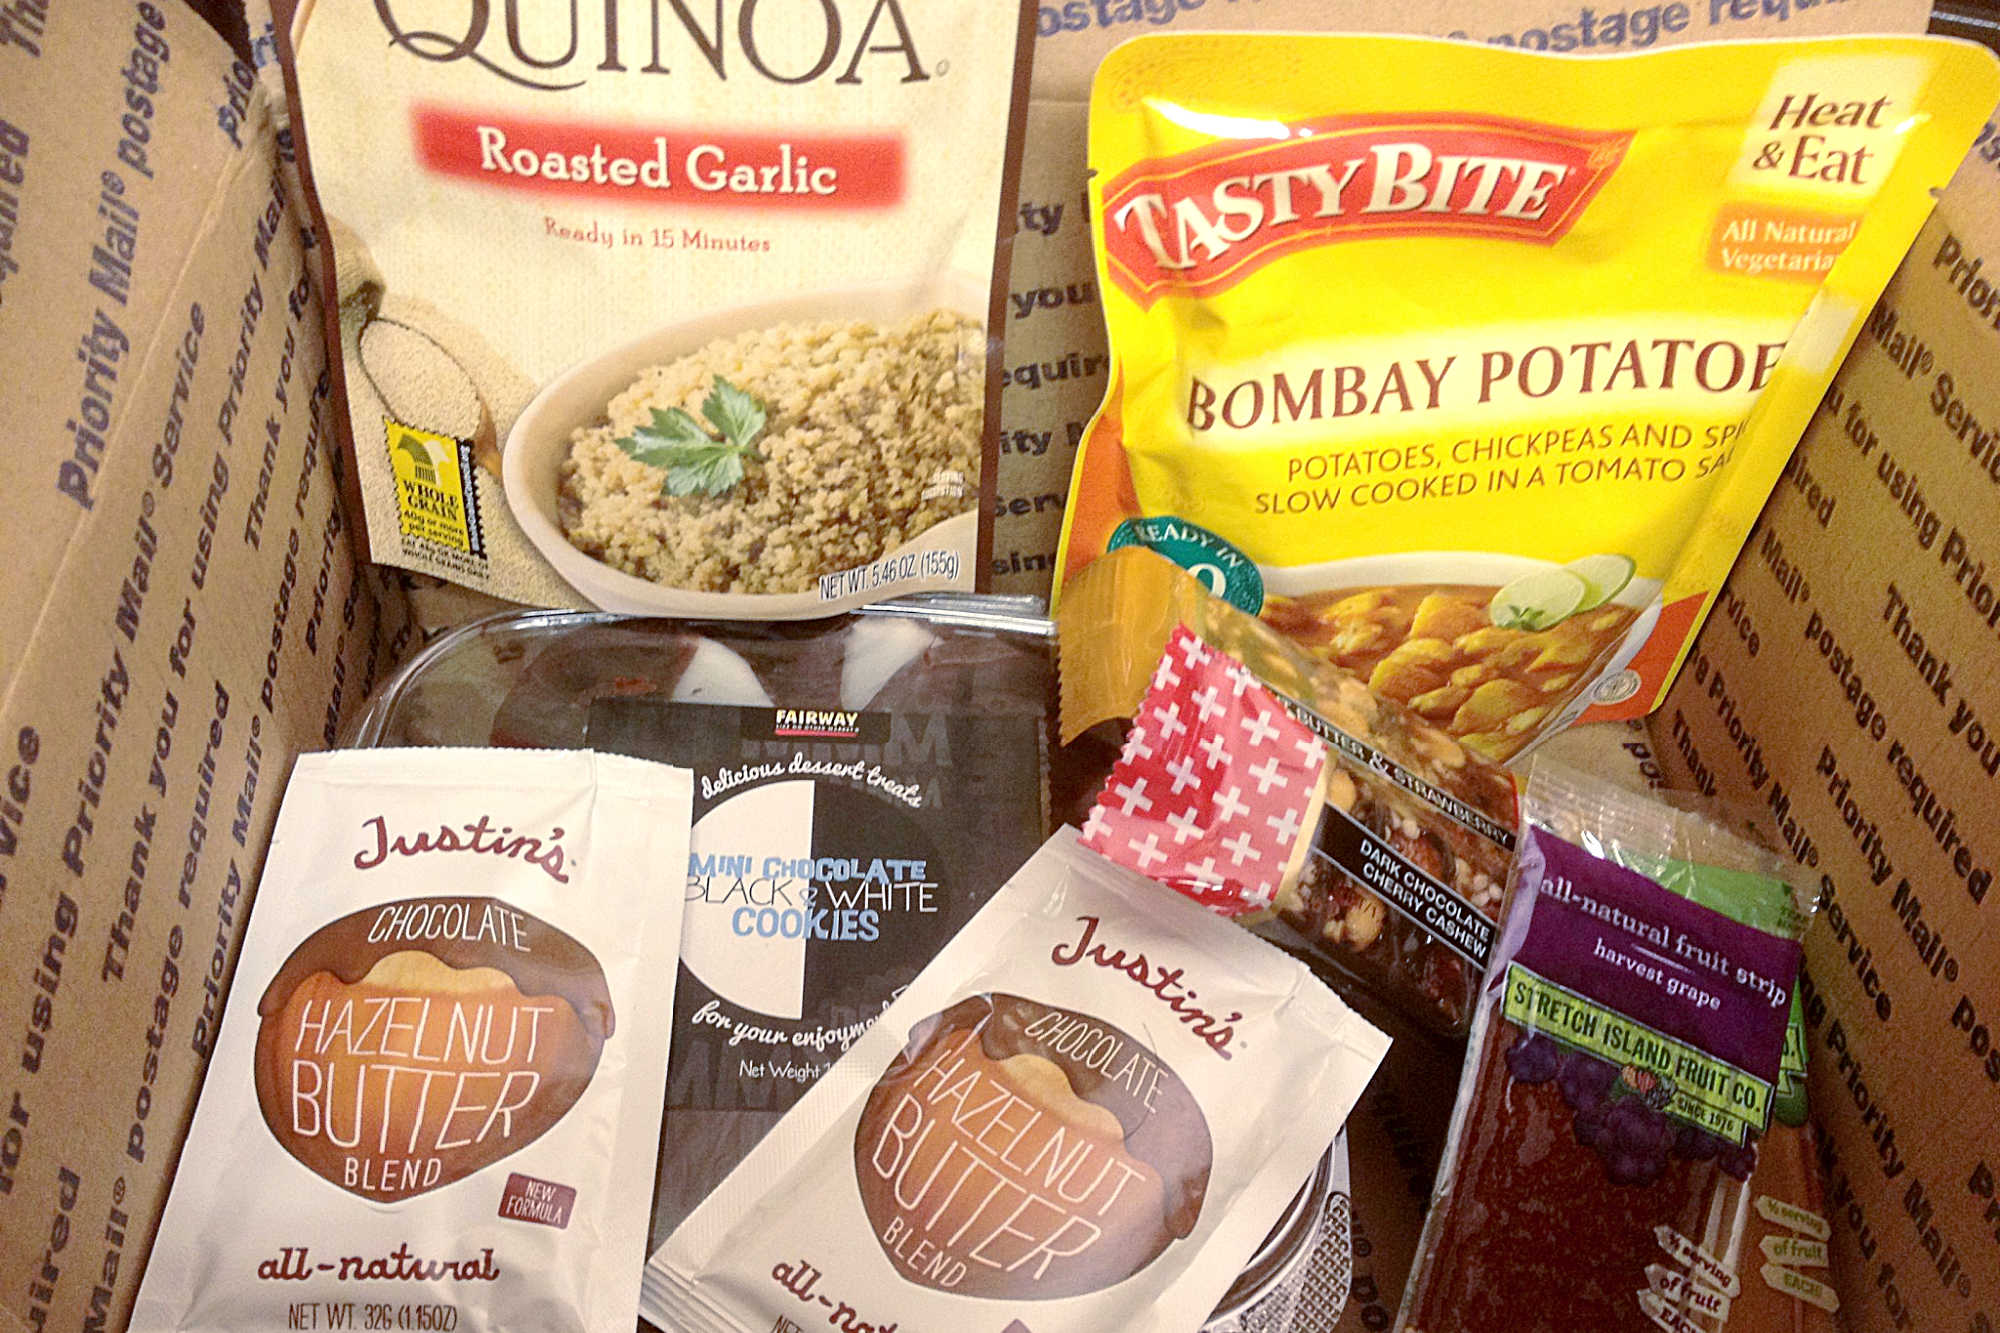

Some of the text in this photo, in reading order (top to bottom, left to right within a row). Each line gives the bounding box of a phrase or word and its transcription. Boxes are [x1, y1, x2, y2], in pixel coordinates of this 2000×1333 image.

[373, 0, 931, 91] QUINOA
[1769, 94, 1890, 132] Heat
[476, 125, 839, 196] Roasted Garlic
[1752, 135, 1876, 185] & Eat
[543, 215, 772, 254] Ready in 15 Minutes
[1115, 142, 1567, 271] TASTY BITE
[1720, 218, 1857, 245] All Natural
[57, 308, 131, 511] Priority
[117, 1, 170, 180] postage
[1186, 356, 1458, 433] BOMBAY
[244, 325, 295, 552] Thank you
[1288, 443, 1441, 484] POTATOES,
[1450, 425, 1613, 465] CHICKPEAS
[1620, 422, 1692, 450] AND
[1844, 401, 1879, 458] for
[1876, 447, 1942, 550] using
[1255, 489, 1341, 516] SLOW
[1350, 471, 1477, 502] COOKED
[1488, 469, 1520, 491] IN
[1525, 466, 1545, 487] A
[1552, 453, 1686, 488] TOMATO
[820, 573, 845, 601] NET
[847, 566, 871, 594] WT.
[871, 558, 898, 588] 5.46
[920, 550, 960, 584] (155g)
[1215, 546, 1245, 569] IN
[101, 801, 157, 983] Thank
[148, 688, 179, 798] you
[169, 597, 196, 680] for
[191, 451, 230, 591] using
[218, 273, 264, 446] Priority
[22, 891, 79, 1075] using
[62, 646, 131, 879] Priority
[152, 301, 205, 489] Service
[1883, 580, 2000, 778] Thank you
[776, 708, 859, 729] FAIRWAY
[193, 857, 241, 1062] Priority
[261, 525, 300, 714] postage
[701, 751, 923, 808] delicious dessert treats
[1804, 608, 1887, 742] postage
[1888, 740, 1993, 906] required
[353, 815, 569, 884] Justin's
[1708, 670, 1770, 792] Priority
[1817, 872, 1892, 1023] Service
[1816, 744, 1894, 887] Priority
[689, 852, 927, 886] MINI CHOCOLATE
[824, 880, 939, 912] WHITE
[1359, 838, 1490, 943] DARK CHOCOLATE
[127, 923, 184, 1164] postage
[178, 678, 230, 910] required
[367, 902, 532, 953] CHOCOLATE
[732, 906, 880, 942] COOKIES
[1362, 860, 1488, 958] CHERRY CASHEW
[1541, 875, 1670, 950] all-natural
[1675, 931, 1731, 977] fruit
[1736, 965, 1788, 1008] strip
[1051, 916, 1244, 1061] Justin's
[1593, 935, 1722, 1013] harvest grape
[293, 996, 555, 1066] HAZELNUT
[691, 1000, 732, 1030] for
[728, 1022, 788, 1046] your
[1513, 980, 1762, 1114] STRETCH ISLAND FRUIT CO.
[739, 1060, 821, 1083] Net Weight
[1024, 1011, 1170, 1116] CHOCOLATE
[1826, 1018, 1905, 1180] Priority
[291, 1058, 542, 1155] BUTTER
[912, 1047, 1147, 1217] HAZELNUT
[343, 1157, 442, 1192] BLEND
[504, 1198, 565, 1225] FORMULA
[524, 1179, 557, 1202] NEW
[871, 1093, 1103, 1281] BUTTER
[257, 1242, 501, 1282] all-natural
[882, 1216, 968, 1289] BLEND
[287, 1304, 319, 1332] NET
[326, 1304, 361, 1332] WT.
[363, 1304, 393, 1332] 32G
